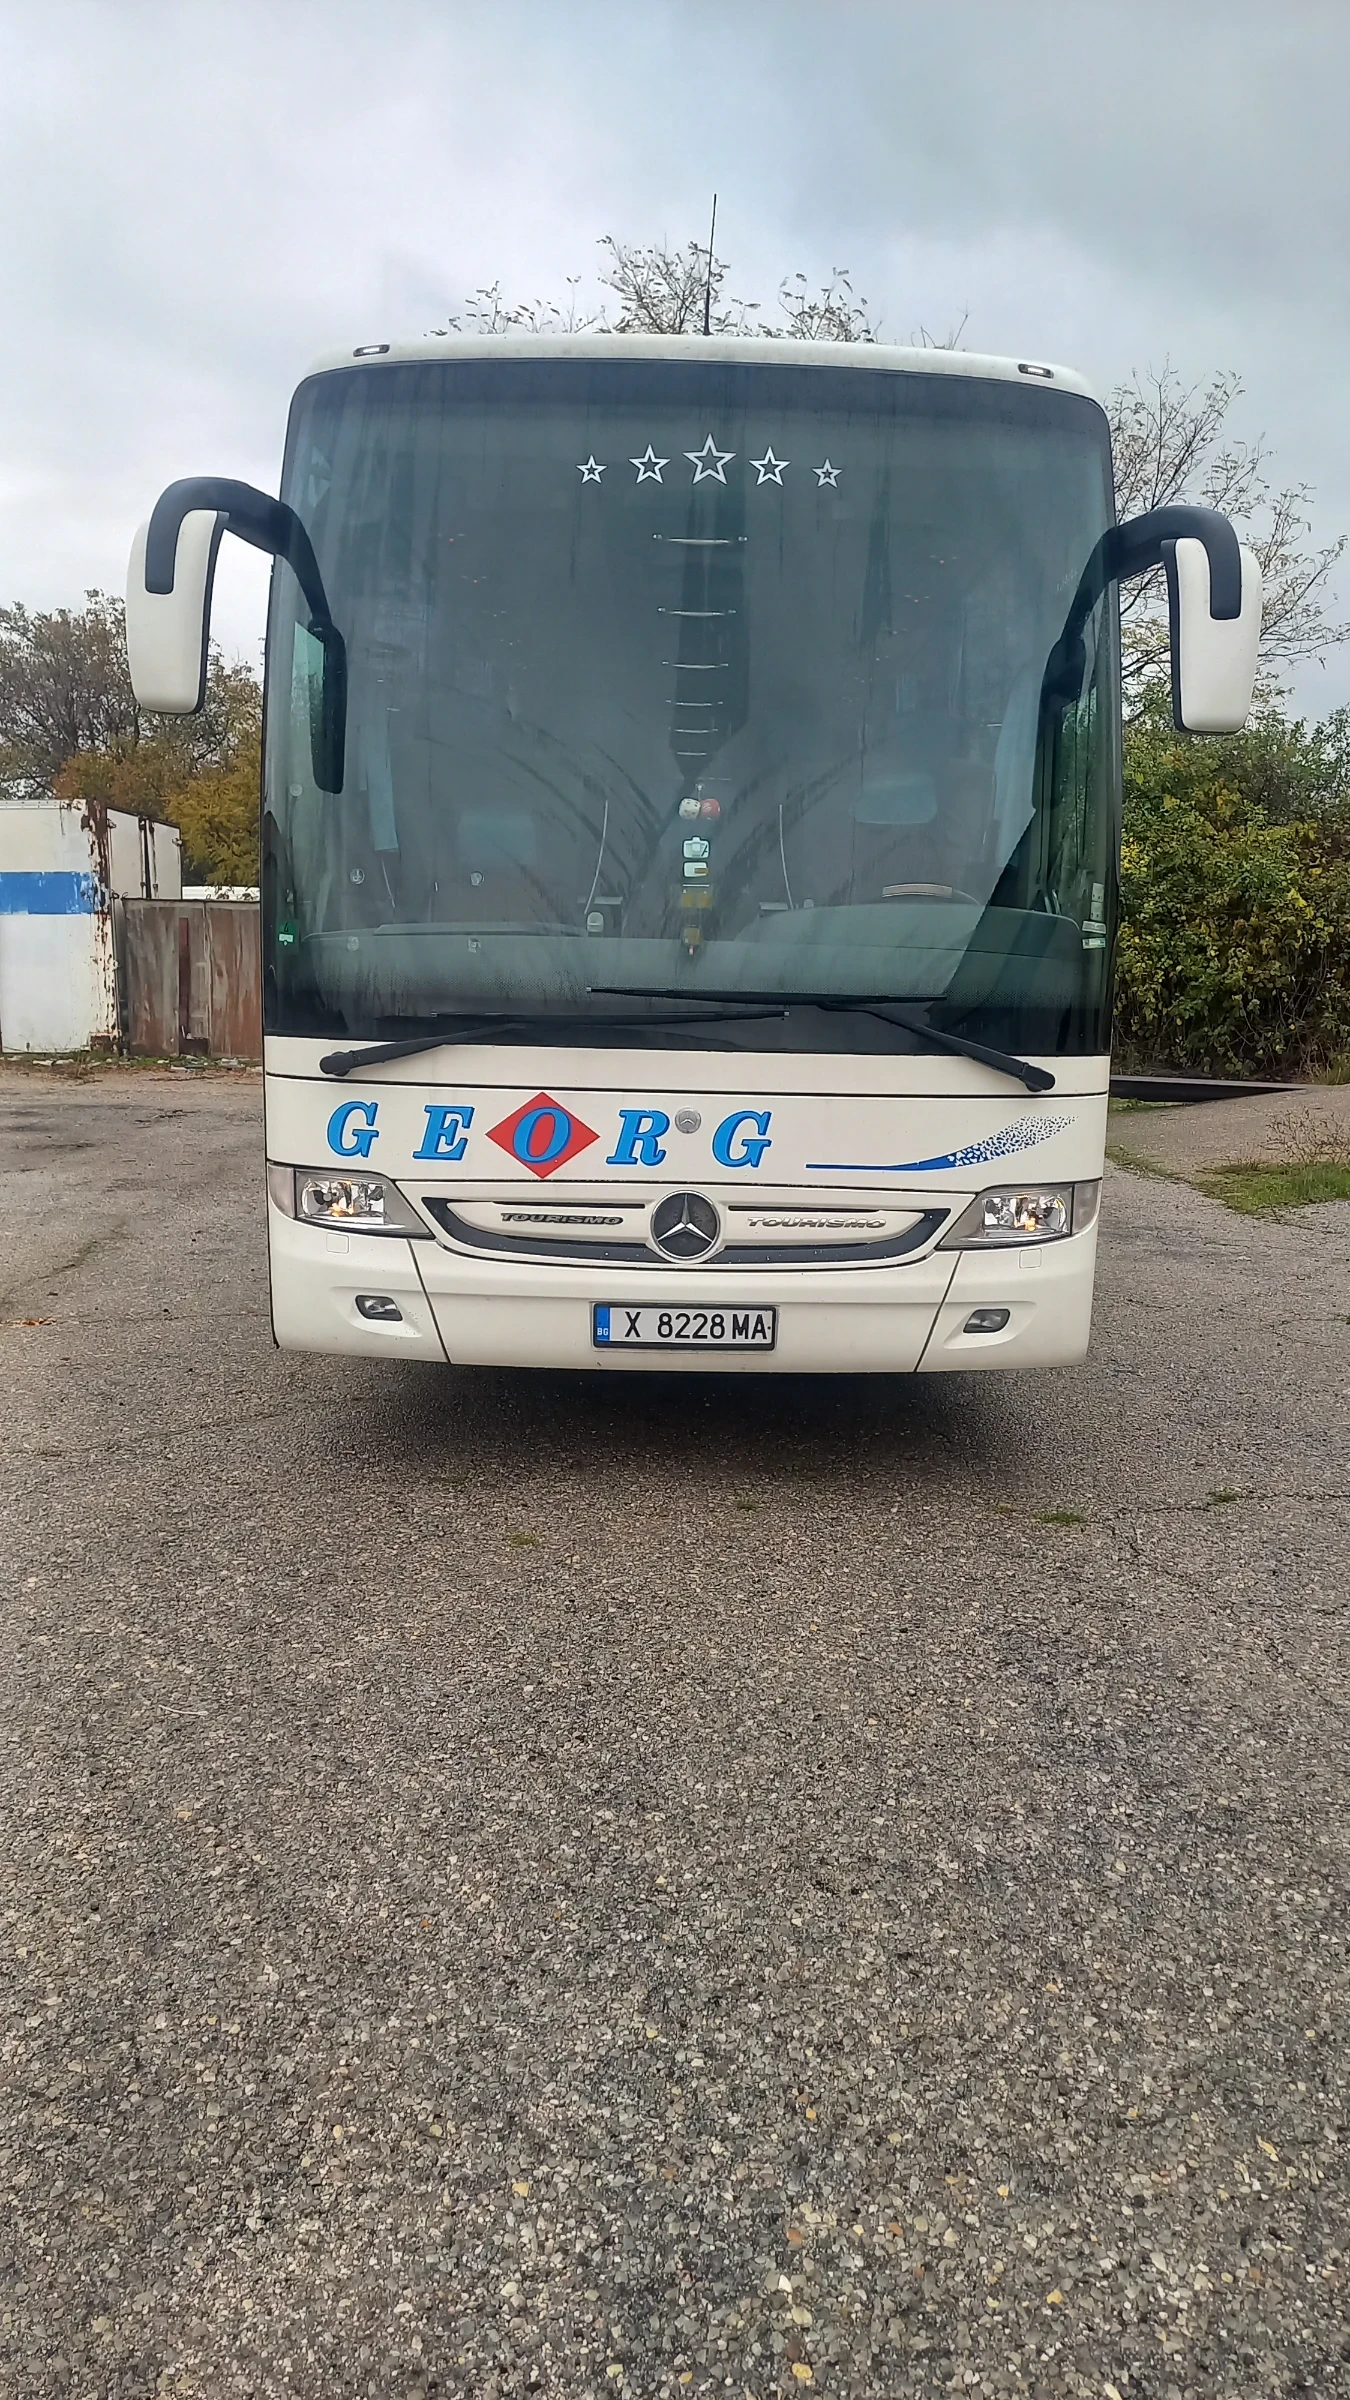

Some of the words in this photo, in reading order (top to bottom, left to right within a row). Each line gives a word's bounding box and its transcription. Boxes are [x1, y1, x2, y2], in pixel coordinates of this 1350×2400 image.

[326, 1101, 772, 1168] GEORG
[500, 1212, 624, 1226] TOURISMO
[748, 1216, 887, 1229] TOURISMO
[597, 1327, 609, 1336] BG
[624, 1311, 642, 1338] X
[657, 1313, 726, 1340] 8228
[732, 1313, 768, 1340] MA
